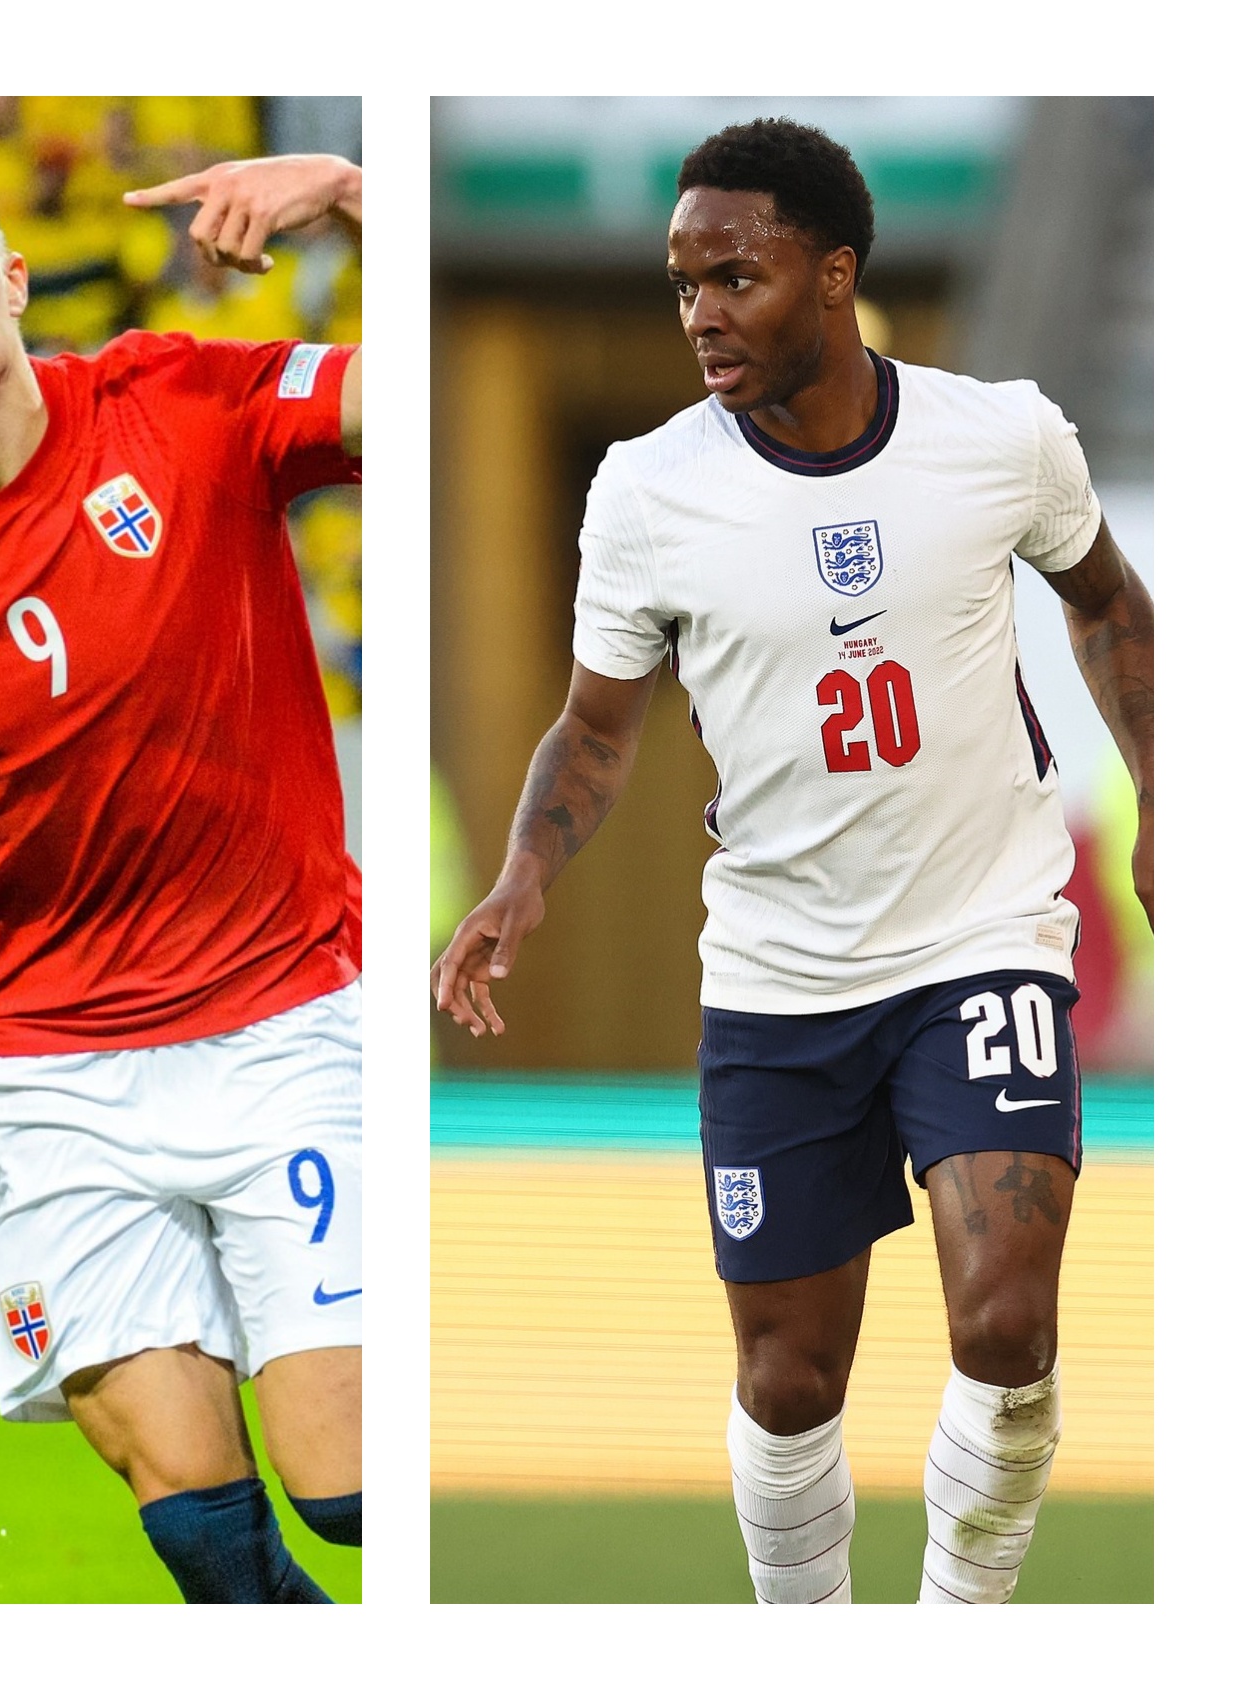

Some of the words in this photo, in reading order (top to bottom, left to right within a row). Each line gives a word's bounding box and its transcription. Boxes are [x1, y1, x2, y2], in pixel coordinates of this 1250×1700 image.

[6, 596, 68, 699] 9
[838, 651, 846, 660] 14
[848, 649, 867, 659] JUNE
[868, 645, 884, 656] 2022
[843, 637, 877, 650] HUNGARY
[816, 660, 921, 773] 20
[959, 982, 1058, 1080] 20
[287, 1148, 335, 1245] 9
